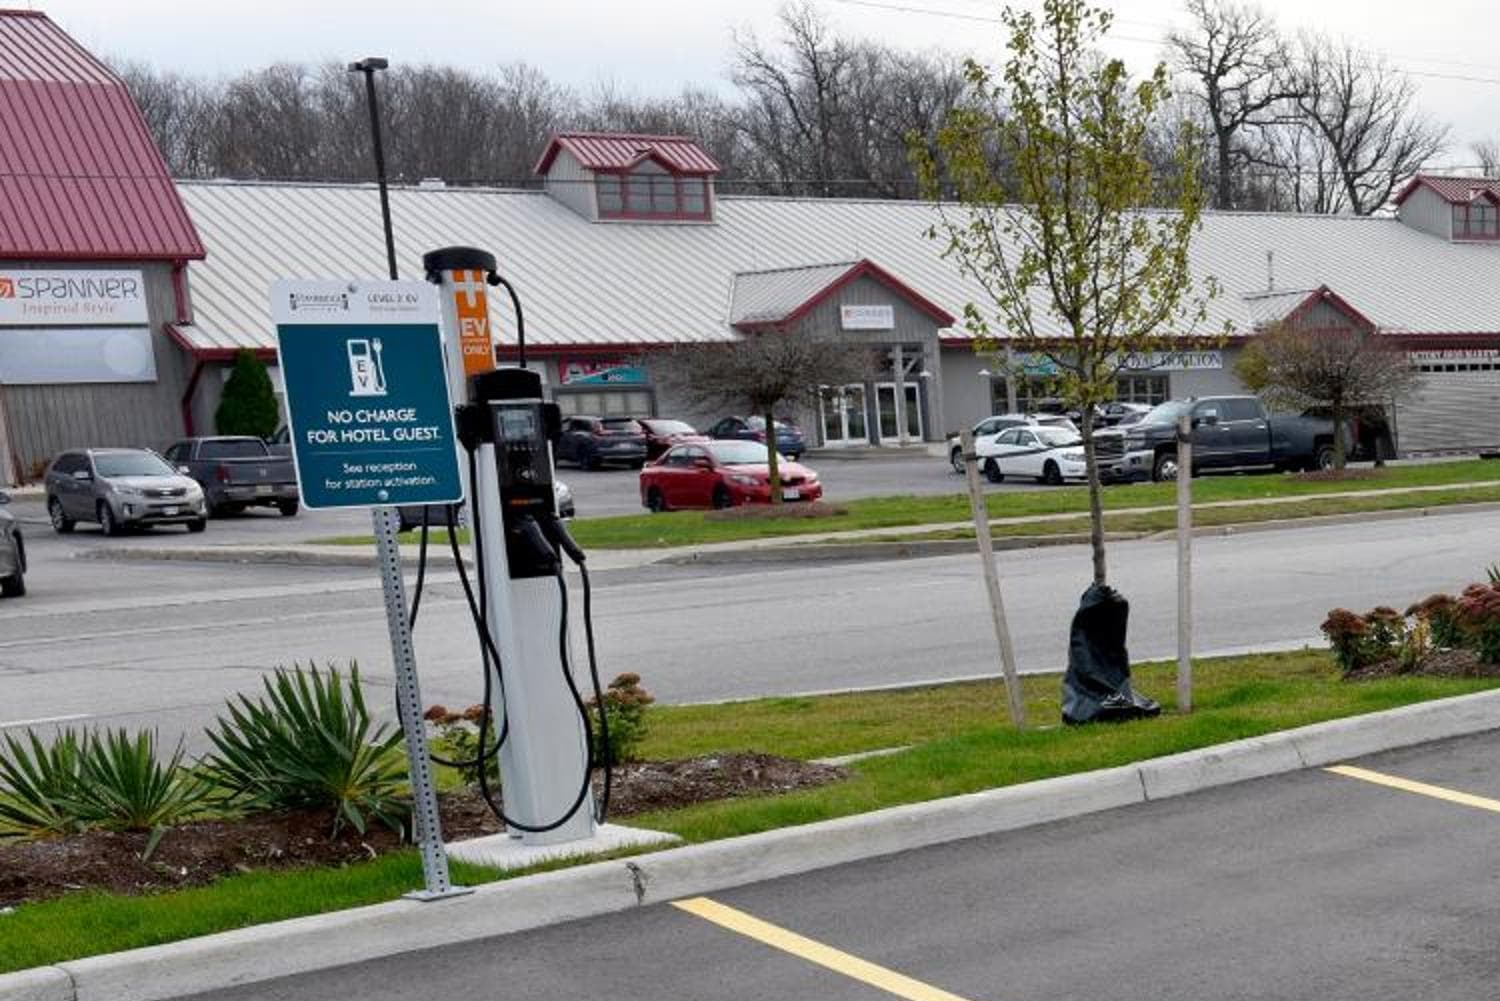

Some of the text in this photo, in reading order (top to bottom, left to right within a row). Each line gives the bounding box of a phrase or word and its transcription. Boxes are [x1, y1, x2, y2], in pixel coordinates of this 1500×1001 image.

[461, 317, 487, 337] EV
[327, 408, 417, 423] NO CHARGE
[307, 429, 339, 444] FOR
[341, 428, 391, 443] HOTEL
[343, 462, 417, 475] See reception
[325, 479, 341, 489] for
[345, 478, 382, 489] station
